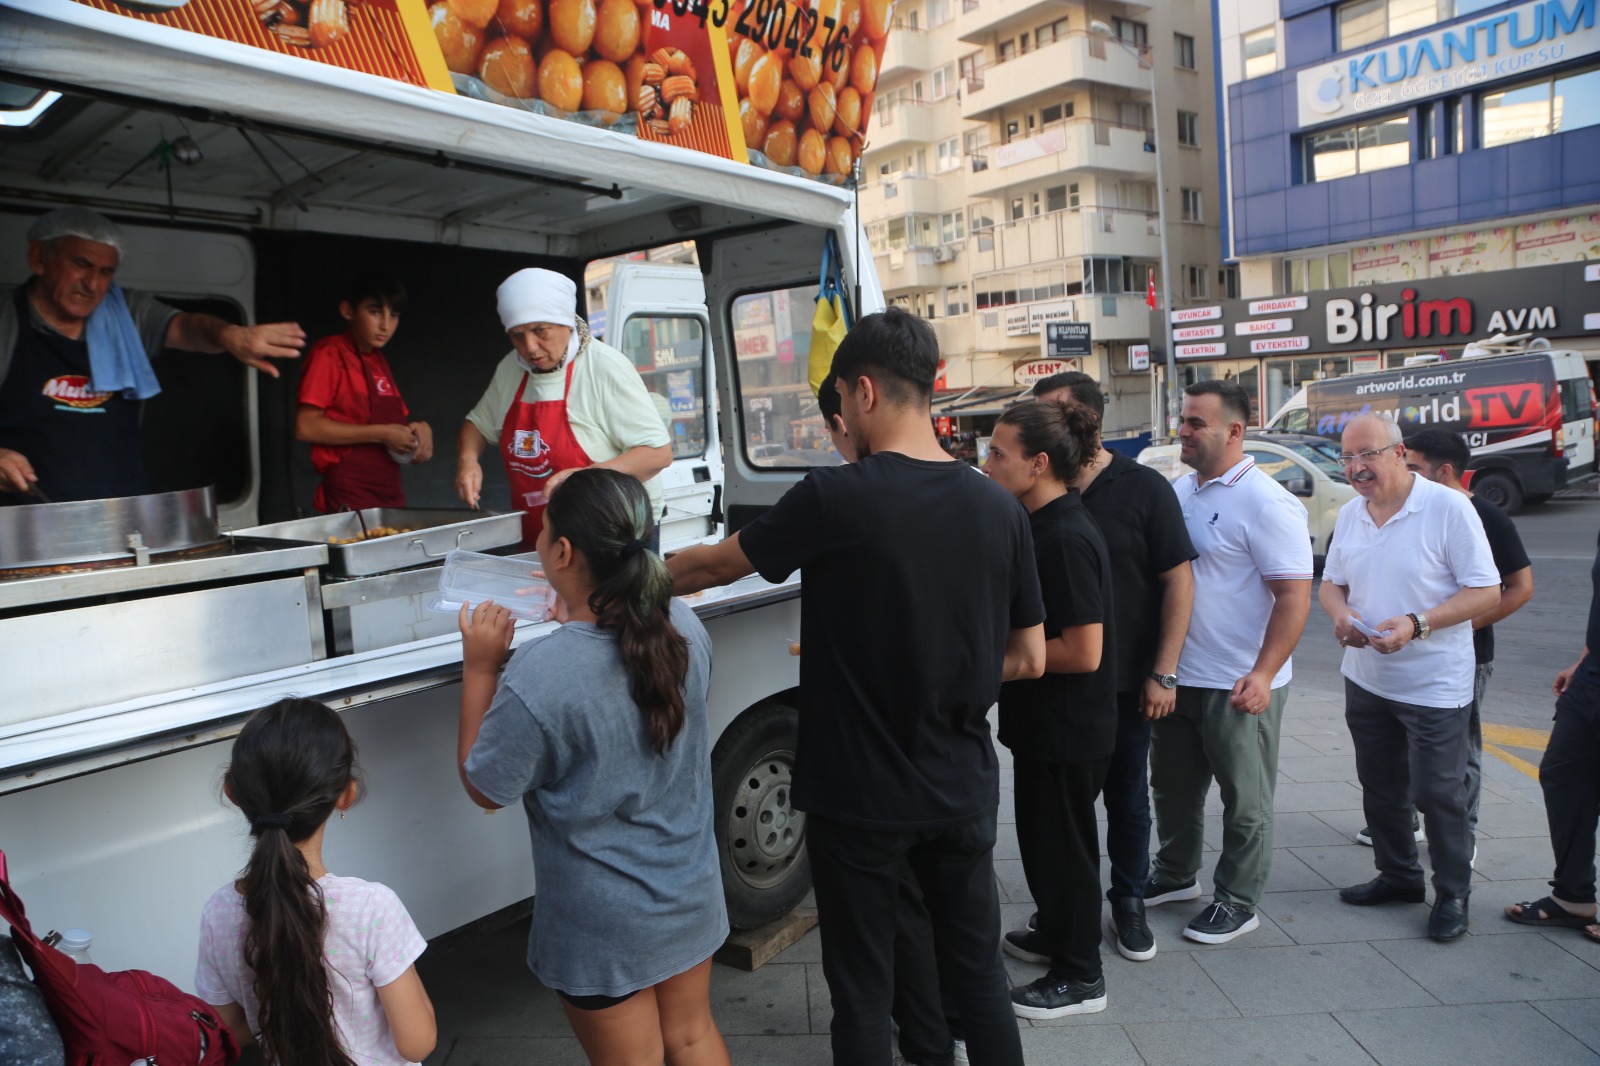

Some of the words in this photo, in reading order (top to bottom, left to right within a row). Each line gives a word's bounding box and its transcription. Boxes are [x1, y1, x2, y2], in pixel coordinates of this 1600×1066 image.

[1350, 0, 1596, 93] KUANTUM
[1354, 90, 1396, 110] ÖZEL
[1402, 66, 1488, 98] ÖĞRETİM
[1494, 43, 1565, 76] KURSU
[1257, 300, 1297, 311] HIRDAVAT
[1178, 309, 1212, 320] OYUNCAK
[1326, 288, 1472, 344] Birim
[1487, 306, 1557, 333] AVM
[1058, 325, 1089, 335] KUANTUM
[1179, 327, 1215, 338] KIRTASİYE
[1249, 321, 1276, 333] BAHÇE
[1183, 344, 1217, 355] ELEKTRİK
[1256, 342, 1265, 350] EV
[1267, 338, 1303, 349] TEKSTİLİ
[1028, 363, 1061, 375] KENT
[1356, 371, 1466, 396] artworld.com.tr
[1472, 389, 1532, 422] TV
